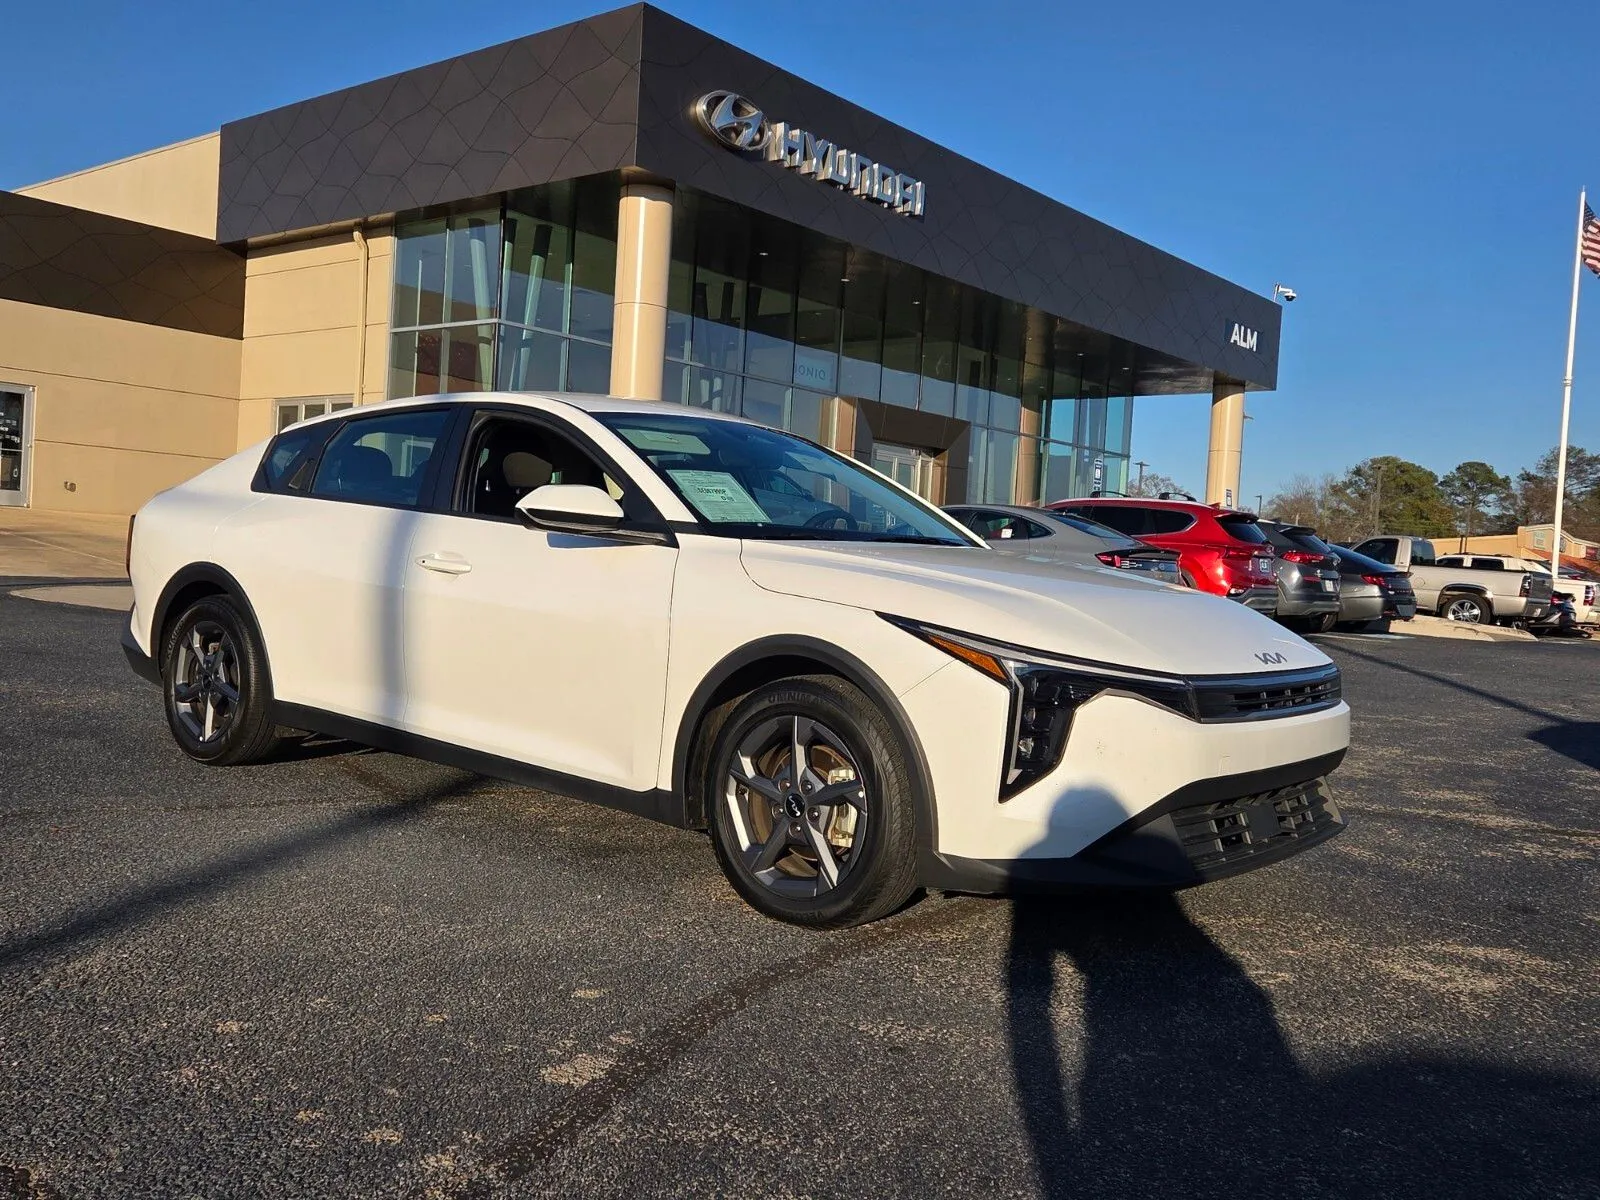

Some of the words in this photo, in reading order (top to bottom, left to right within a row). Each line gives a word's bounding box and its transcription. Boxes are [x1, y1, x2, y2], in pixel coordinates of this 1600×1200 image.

[767, 121, 926, 217] HYUNDAI
[1229, 323, 1259, 352] ALM
[1254, 652, 1288, 665] KIA
